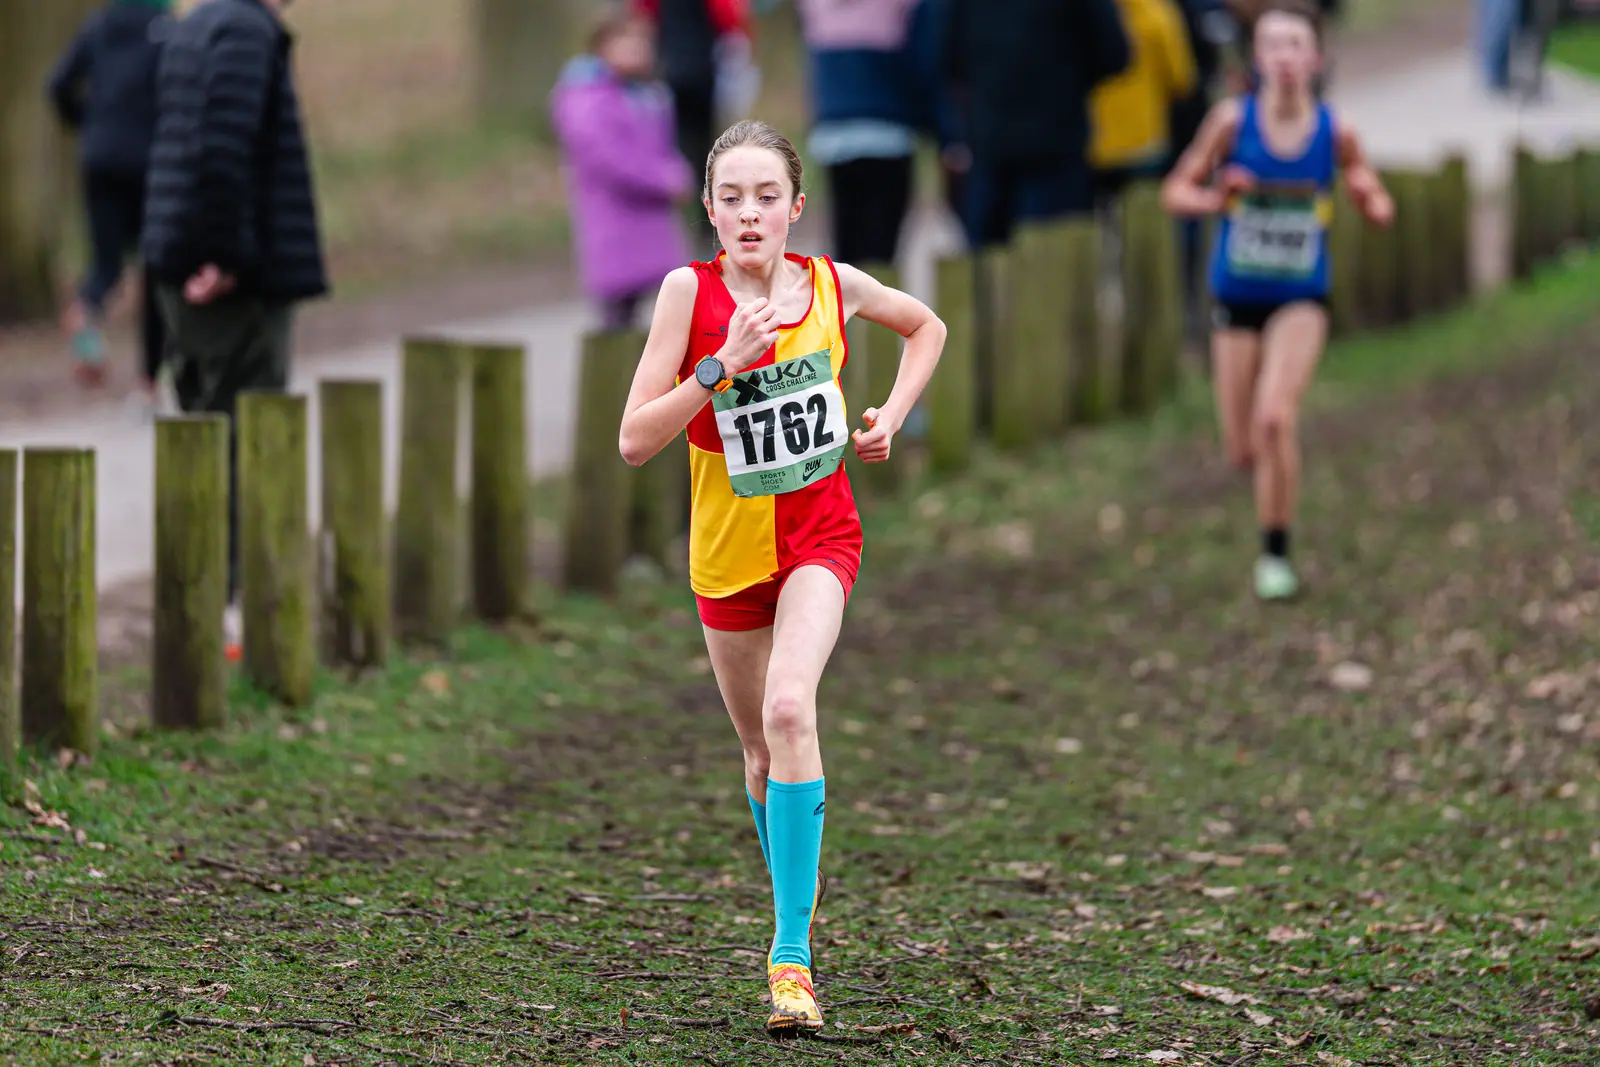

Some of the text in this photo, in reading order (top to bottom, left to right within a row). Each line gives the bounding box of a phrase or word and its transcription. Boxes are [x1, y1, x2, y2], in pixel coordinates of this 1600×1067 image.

[765, 371, 818, 394] CROSS CHALLENGE
[733, 393, 835, 466] 1762
[804, 458, 822, 473] RUN
[760, 471, 786, 480] SPORTS
[761, 478, 784, 486] SHOES
